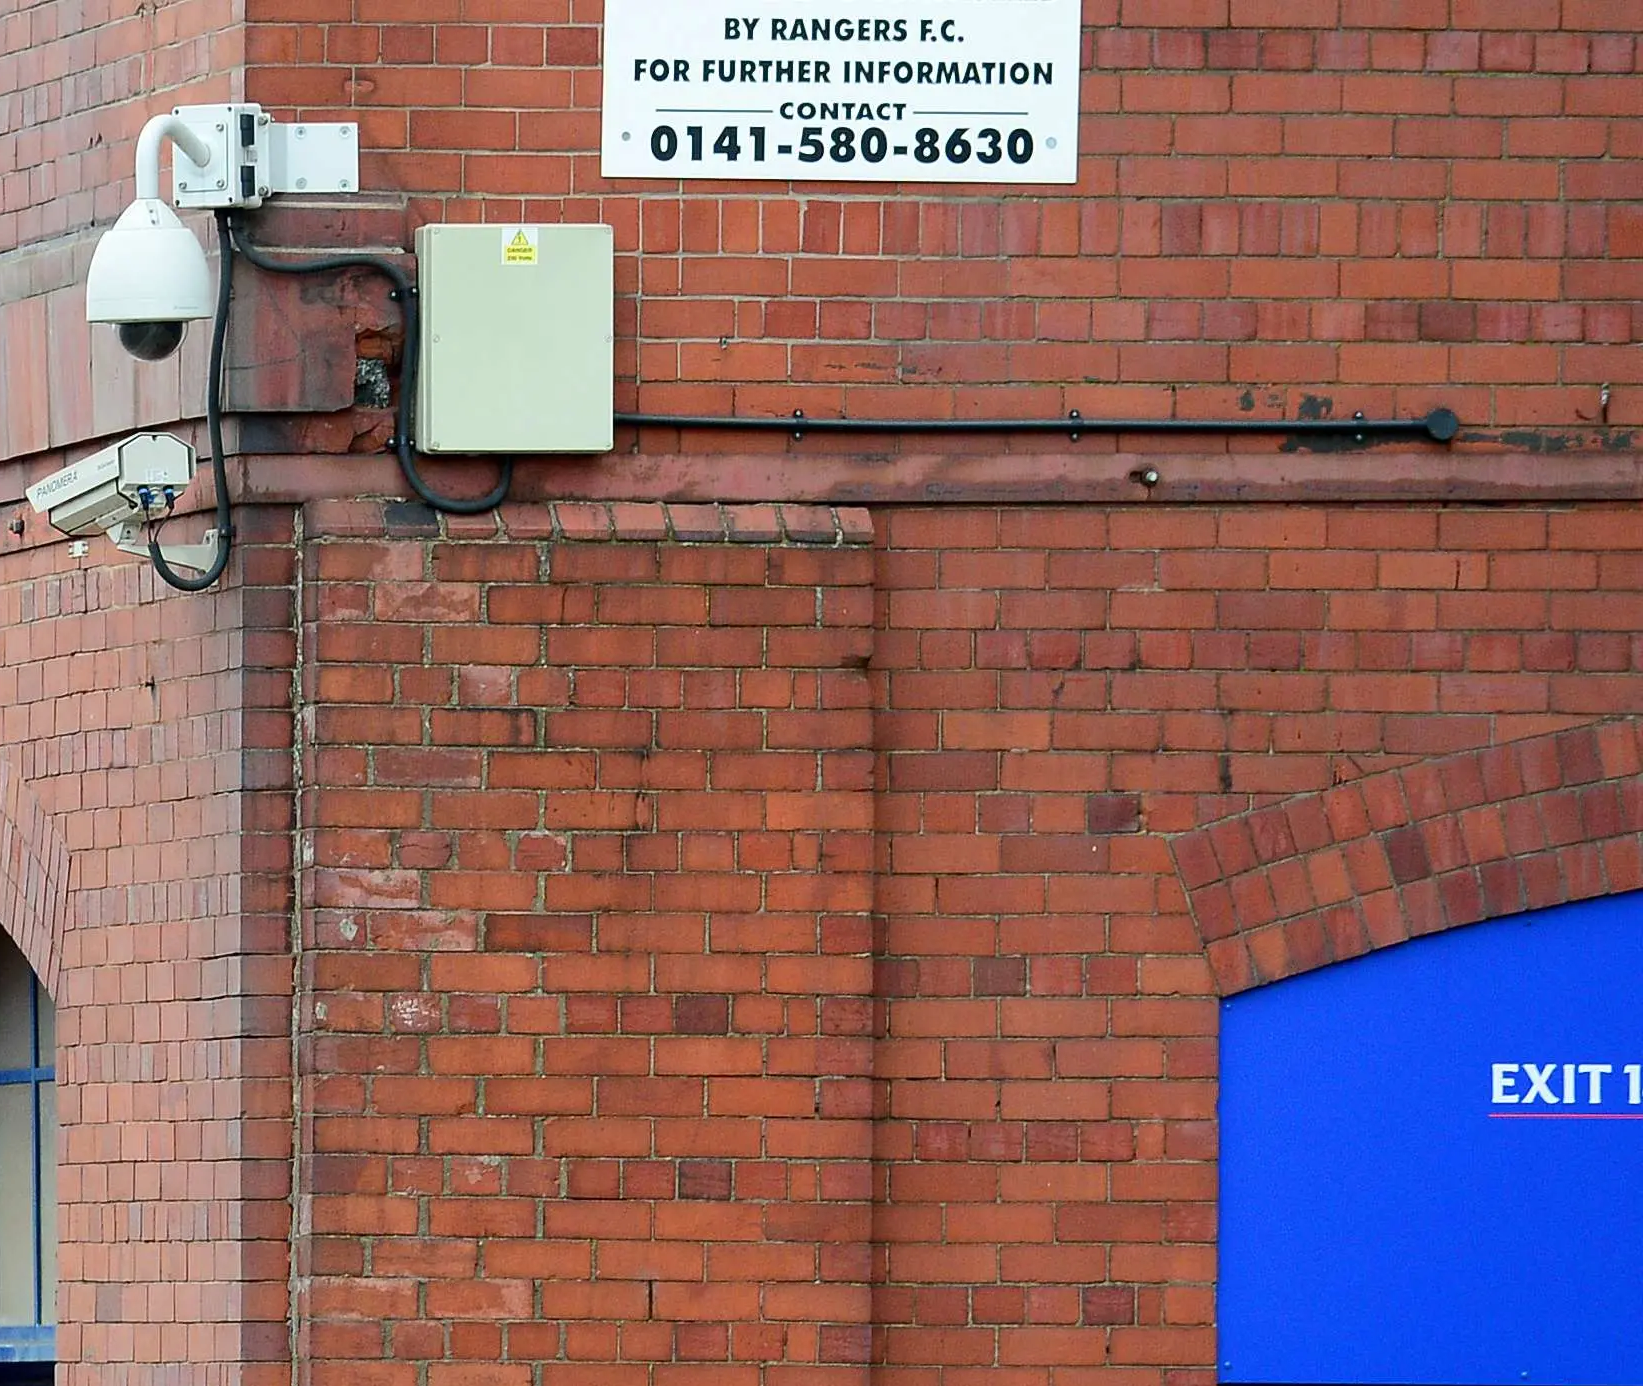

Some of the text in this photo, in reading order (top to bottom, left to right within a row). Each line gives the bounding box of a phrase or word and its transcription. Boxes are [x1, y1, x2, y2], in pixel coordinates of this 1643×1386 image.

[724, 17, 965, 43] BY RANGERS F.C.
[634, 58, 1054, 86] FOR FURTHER INFORMATION
[779, 102, 907, 121] CONTACT
[650, 125, 1034, 165] 0141-580-8630
[1491, 1063, 1643, 1105] EXIT 1
